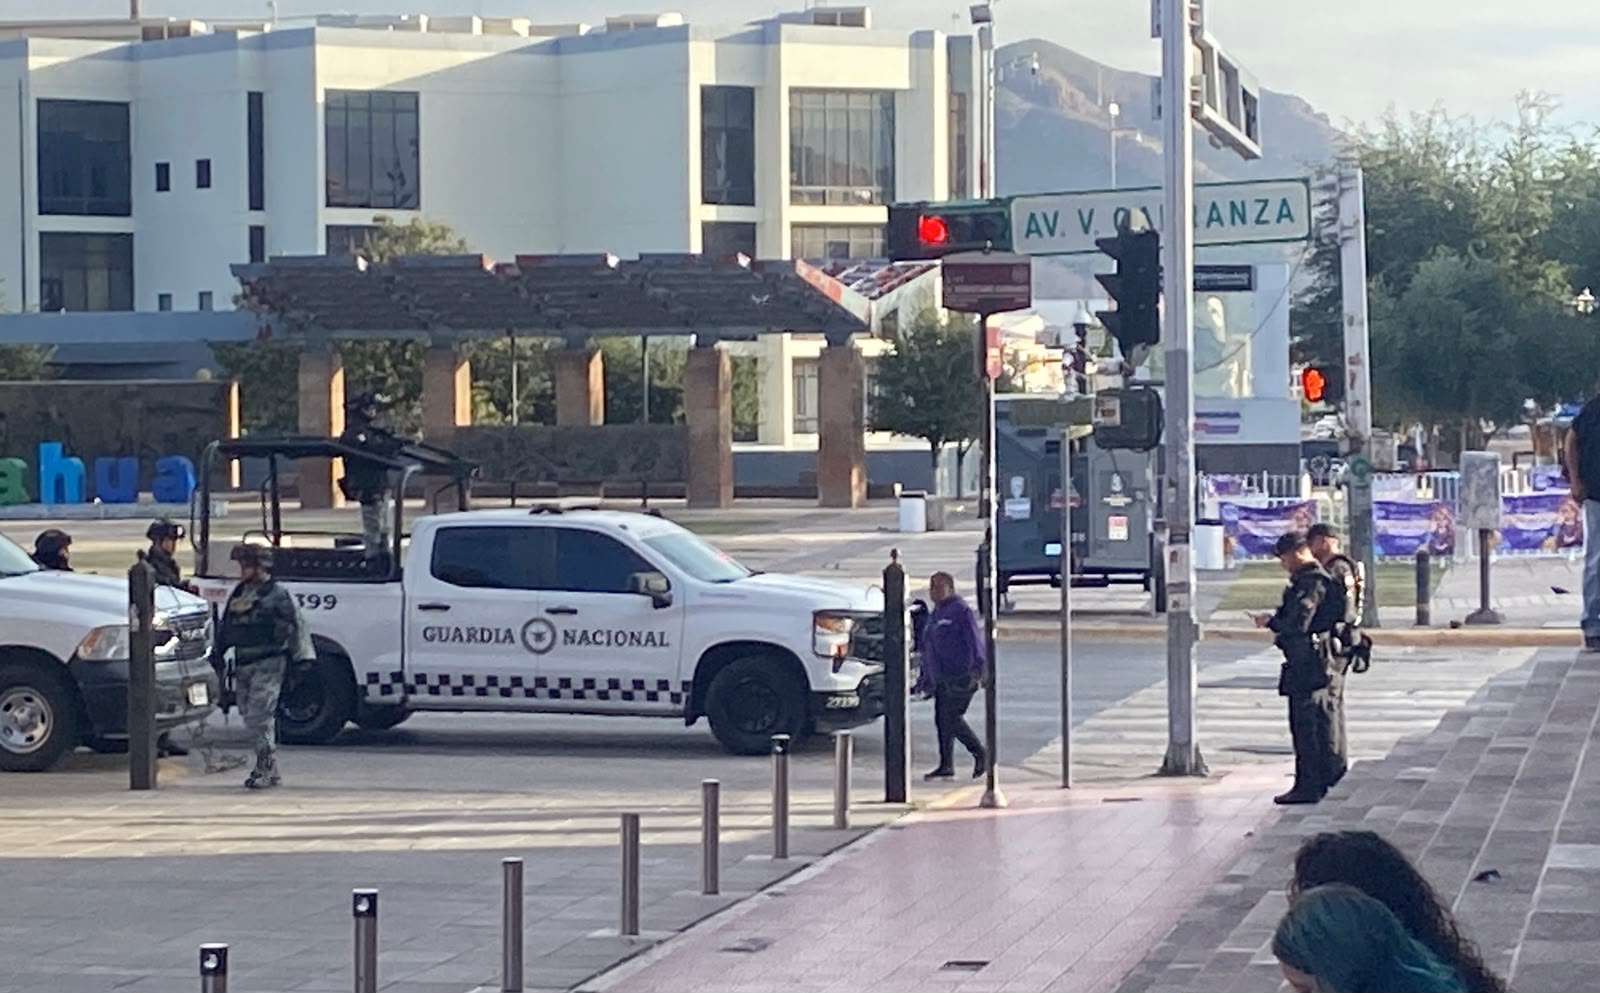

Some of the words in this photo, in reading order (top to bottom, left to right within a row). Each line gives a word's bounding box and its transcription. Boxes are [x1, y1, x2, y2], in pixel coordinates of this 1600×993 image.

[1025, 211, 1066, 238] AV.
[1078, 208, 1100, 236] V.
[422, 626, 516, 645] GUARDIA
[562, 628, 670, 648] NACIONAL
